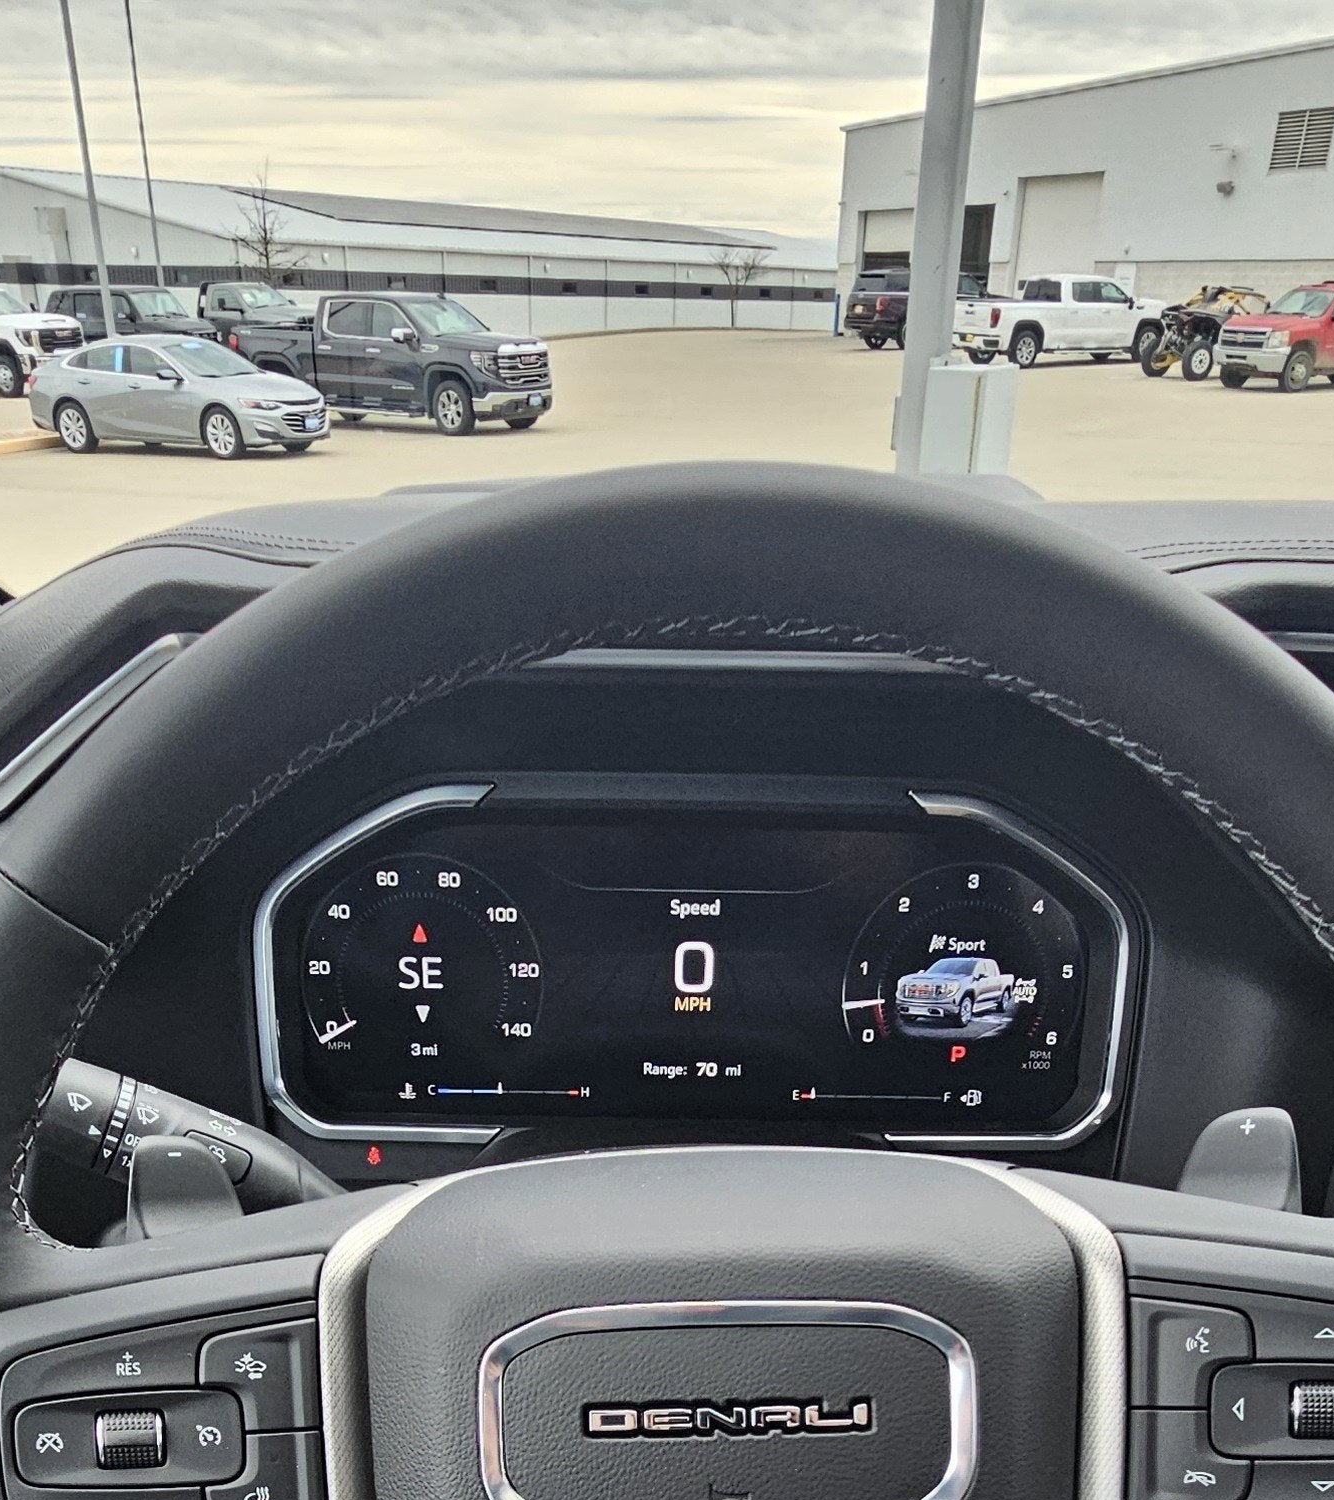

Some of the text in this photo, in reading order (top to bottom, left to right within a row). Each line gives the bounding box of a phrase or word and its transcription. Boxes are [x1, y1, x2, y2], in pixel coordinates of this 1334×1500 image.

[376, 871, 399, 887] 60
[438, 872, 461, 888] 80
[968, 874, 980, 889] 3
[327, 904, 350, 919] 40
[670, 898, 721, 919] Speed
[898, 897, 910, 913] 2
[1032, 899, 1044, 915] 4
[486, 907, 517, 923] 100
[948, 937, 986, 954] Sport
[309, 960, 331, 975] 20
[398, 956, 444, 990] SE
[509, 963, 540, 978] 120
[674, 941, 714, 993] 0
[860, 961, 868, 975] 1
[1062, 964, 1073, 980] 5
[674, 996, 711, 1012] MPH
[326, 1021, 337, 1034] 0
[502, 1022, 532, 1037] 140
[862, 1029, 874, 1043] 0
[1046, 1031, 1057, 1045] 6
[328, 1041, 351, 1051] MPH
[410, 1043, 438, 1056] 3 mi
[950, 1046, 966, 1062] P
[1029, 1050, 1051, 1060] RPM
[643, 1062, 741, 1079] Range: 70 mi
[1021, 1061, 1050, 1070] x1000
[427, 1085, 436, 1096] C
[581, 1086, 590, 1097] H
[792, 1090, 800, 1100] E
[943, 1092, 951, 1102] F
[115, 1361, 142, 1377] RES
[585, 1400, 871, 1434] DENALI
